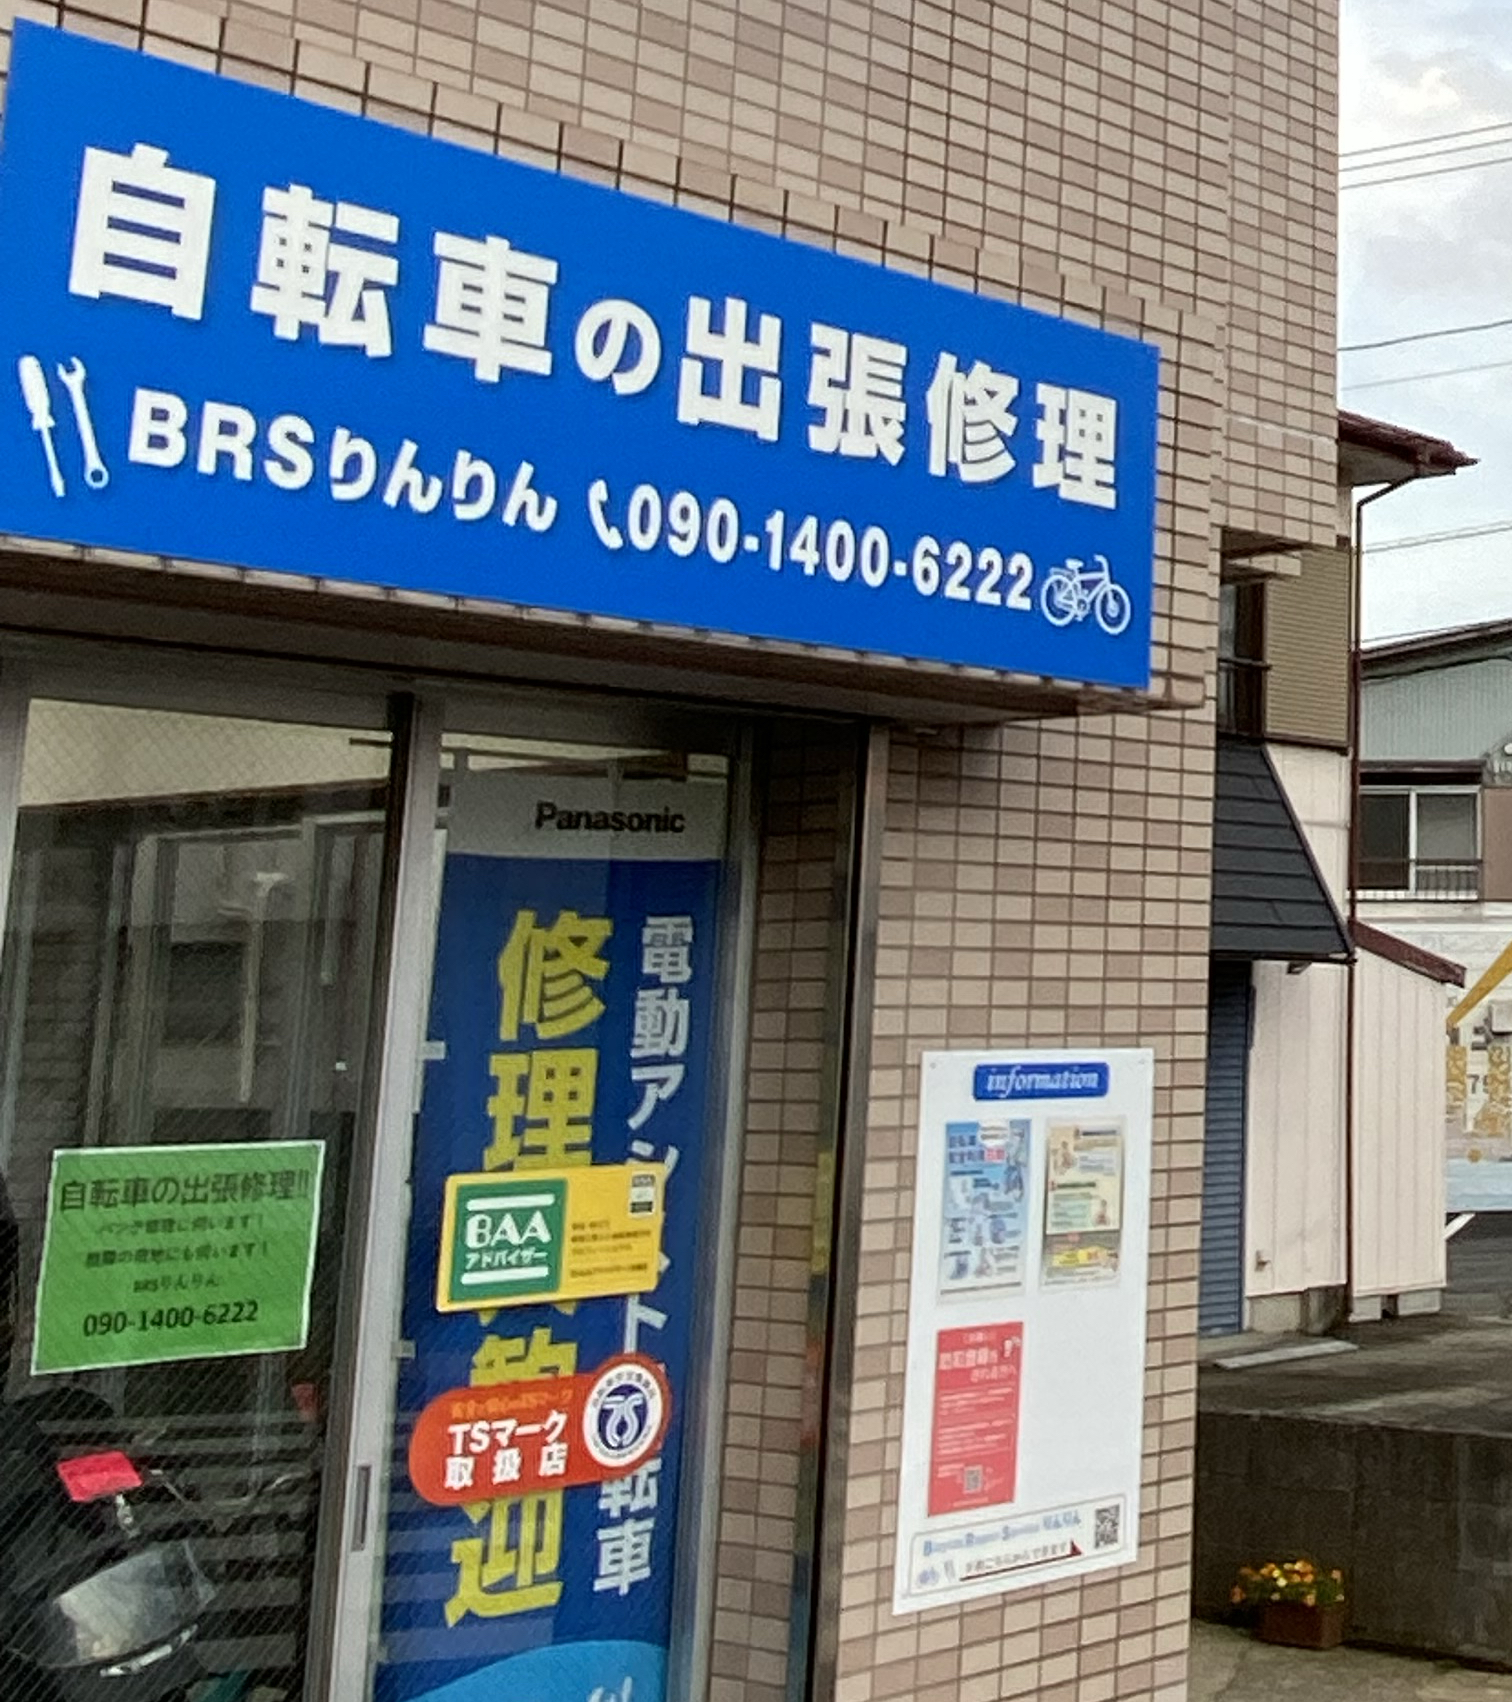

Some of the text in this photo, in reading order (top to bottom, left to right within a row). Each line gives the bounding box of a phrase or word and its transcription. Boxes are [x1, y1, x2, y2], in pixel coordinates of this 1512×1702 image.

[67, 143, 1118, 511] 自転車の出張修理
[127, 387, 558, 532] BRSりんりん
[628, 484, 1034, 611] 090-1400-6222
[535, 802, 685, 833] Panasonic
[986, 1064, 1099, 1098] information
[465, 1210, 552, 1249] BAA
[465, 1246, 548, 1270] アドバイザー
[83, 1300, 259, 1337] 090-1400-6222
[447, 1409, 568, 1455] TSマーク
[444, 1443, 568, 1490] 取扱店
